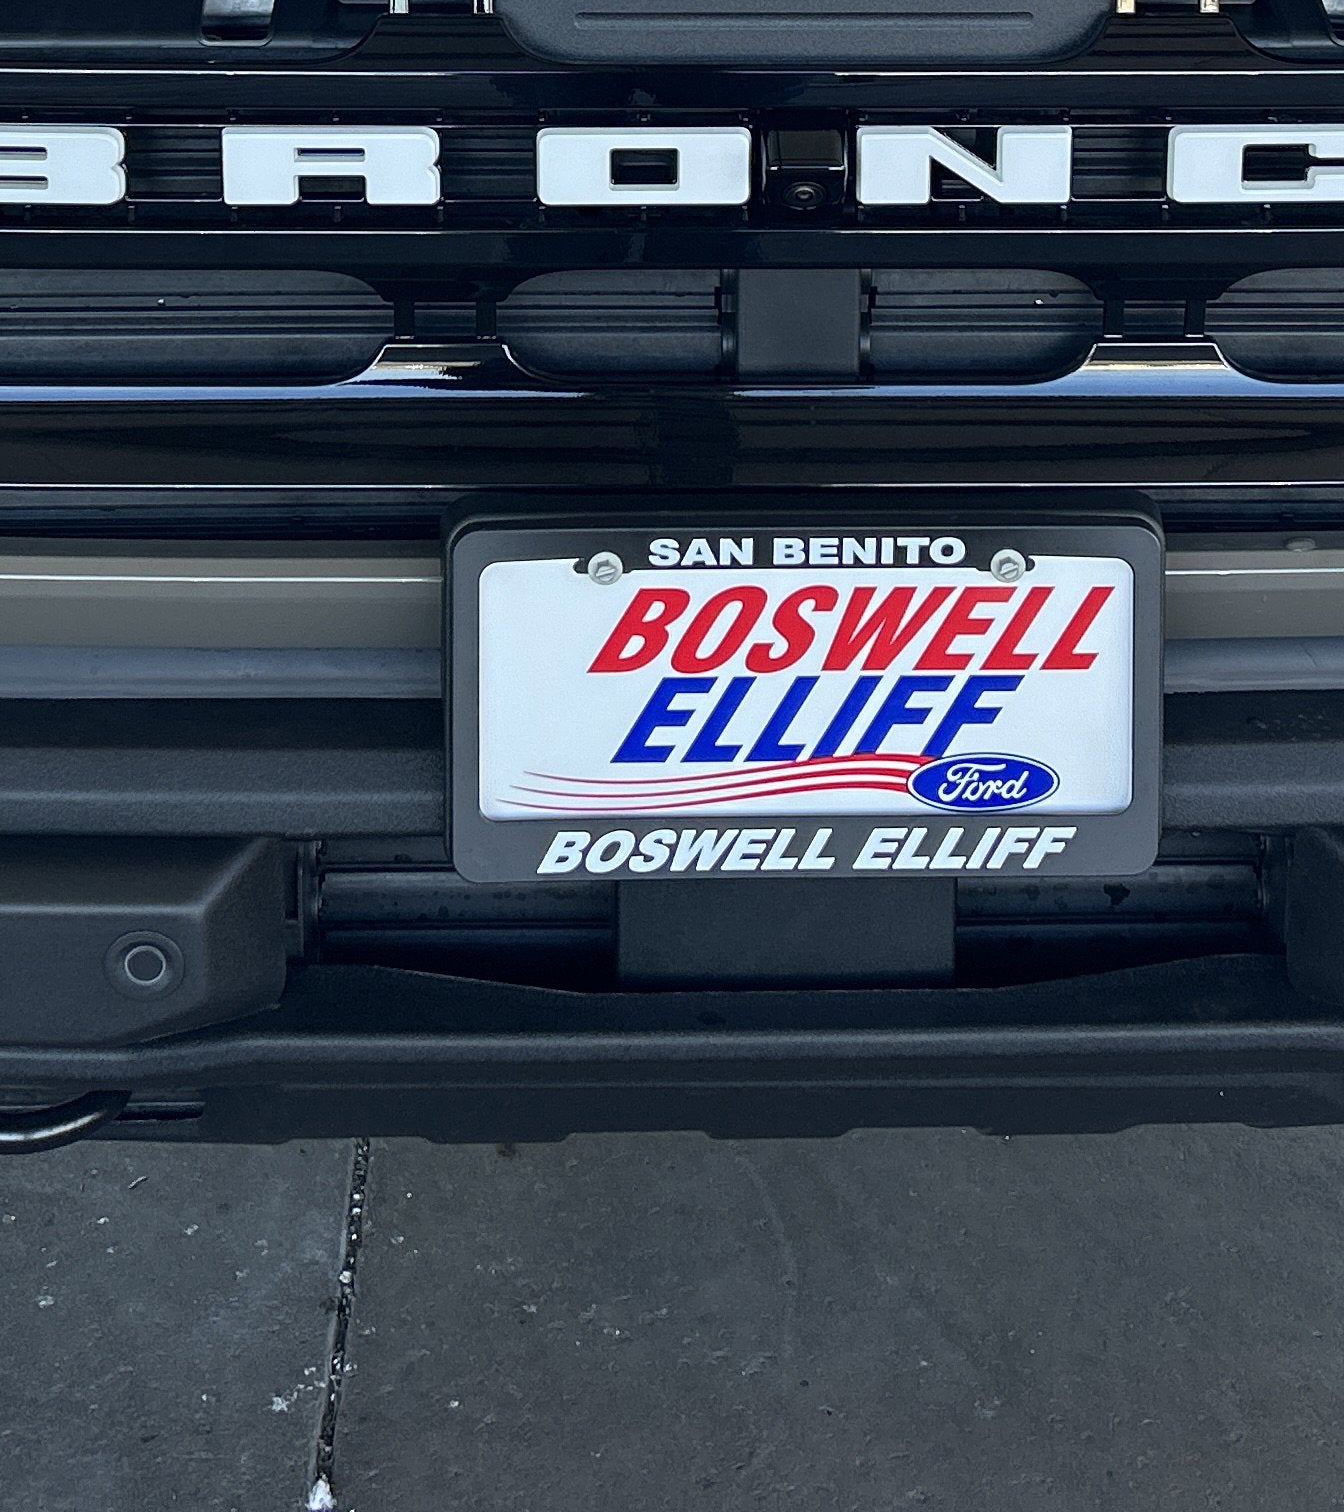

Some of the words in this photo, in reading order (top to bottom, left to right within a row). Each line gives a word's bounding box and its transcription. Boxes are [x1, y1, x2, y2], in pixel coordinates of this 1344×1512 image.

[647, 537, 754, 567] SAN
[772, 536, 966, 566] BENITO
[587, 585, 1115, 674] BOSWELL
[610, 675, 1026, 764] ELLIFF
[937, 763, 1031, 802] Ford
[535, 828, 837, 875] BOSWELL
[851, 826, 1078, 871] ELLIFF
